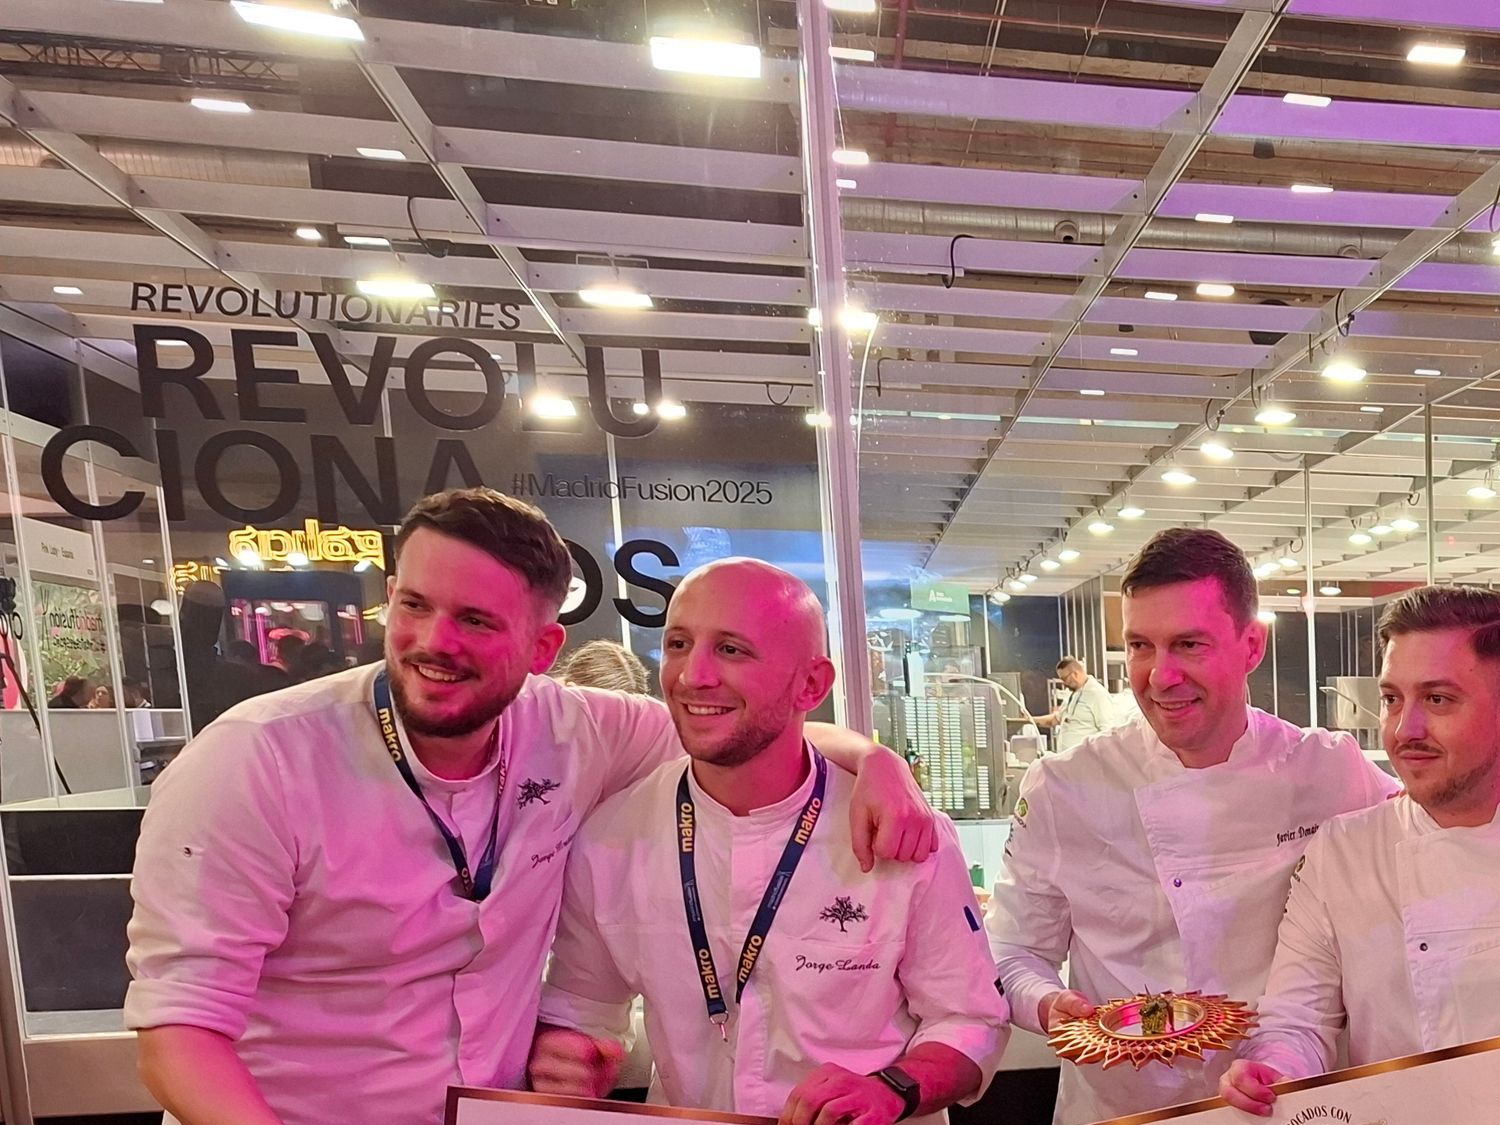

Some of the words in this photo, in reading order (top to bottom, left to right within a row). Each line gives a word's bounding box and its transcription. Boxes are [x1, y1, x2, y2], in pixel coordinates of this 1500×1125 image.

[131, 282, 521, 330] REVOLUTIONARIES
[132, 325, 663, 438] REVOLU
[511, 472, 773, 507] #MadridFusion2025
[379, 708, 402, 762] makro
[681, 802, 693, 853] makro
[794, 797, 821, 845] makro
[699, 948, 720, 999] makro
[738, 934, 763, 984] makro
[795, 955, 834, 972] Jorge
[836, 959, 881, 972] Landa
[1330, 1106, 1352, 1124] CON
